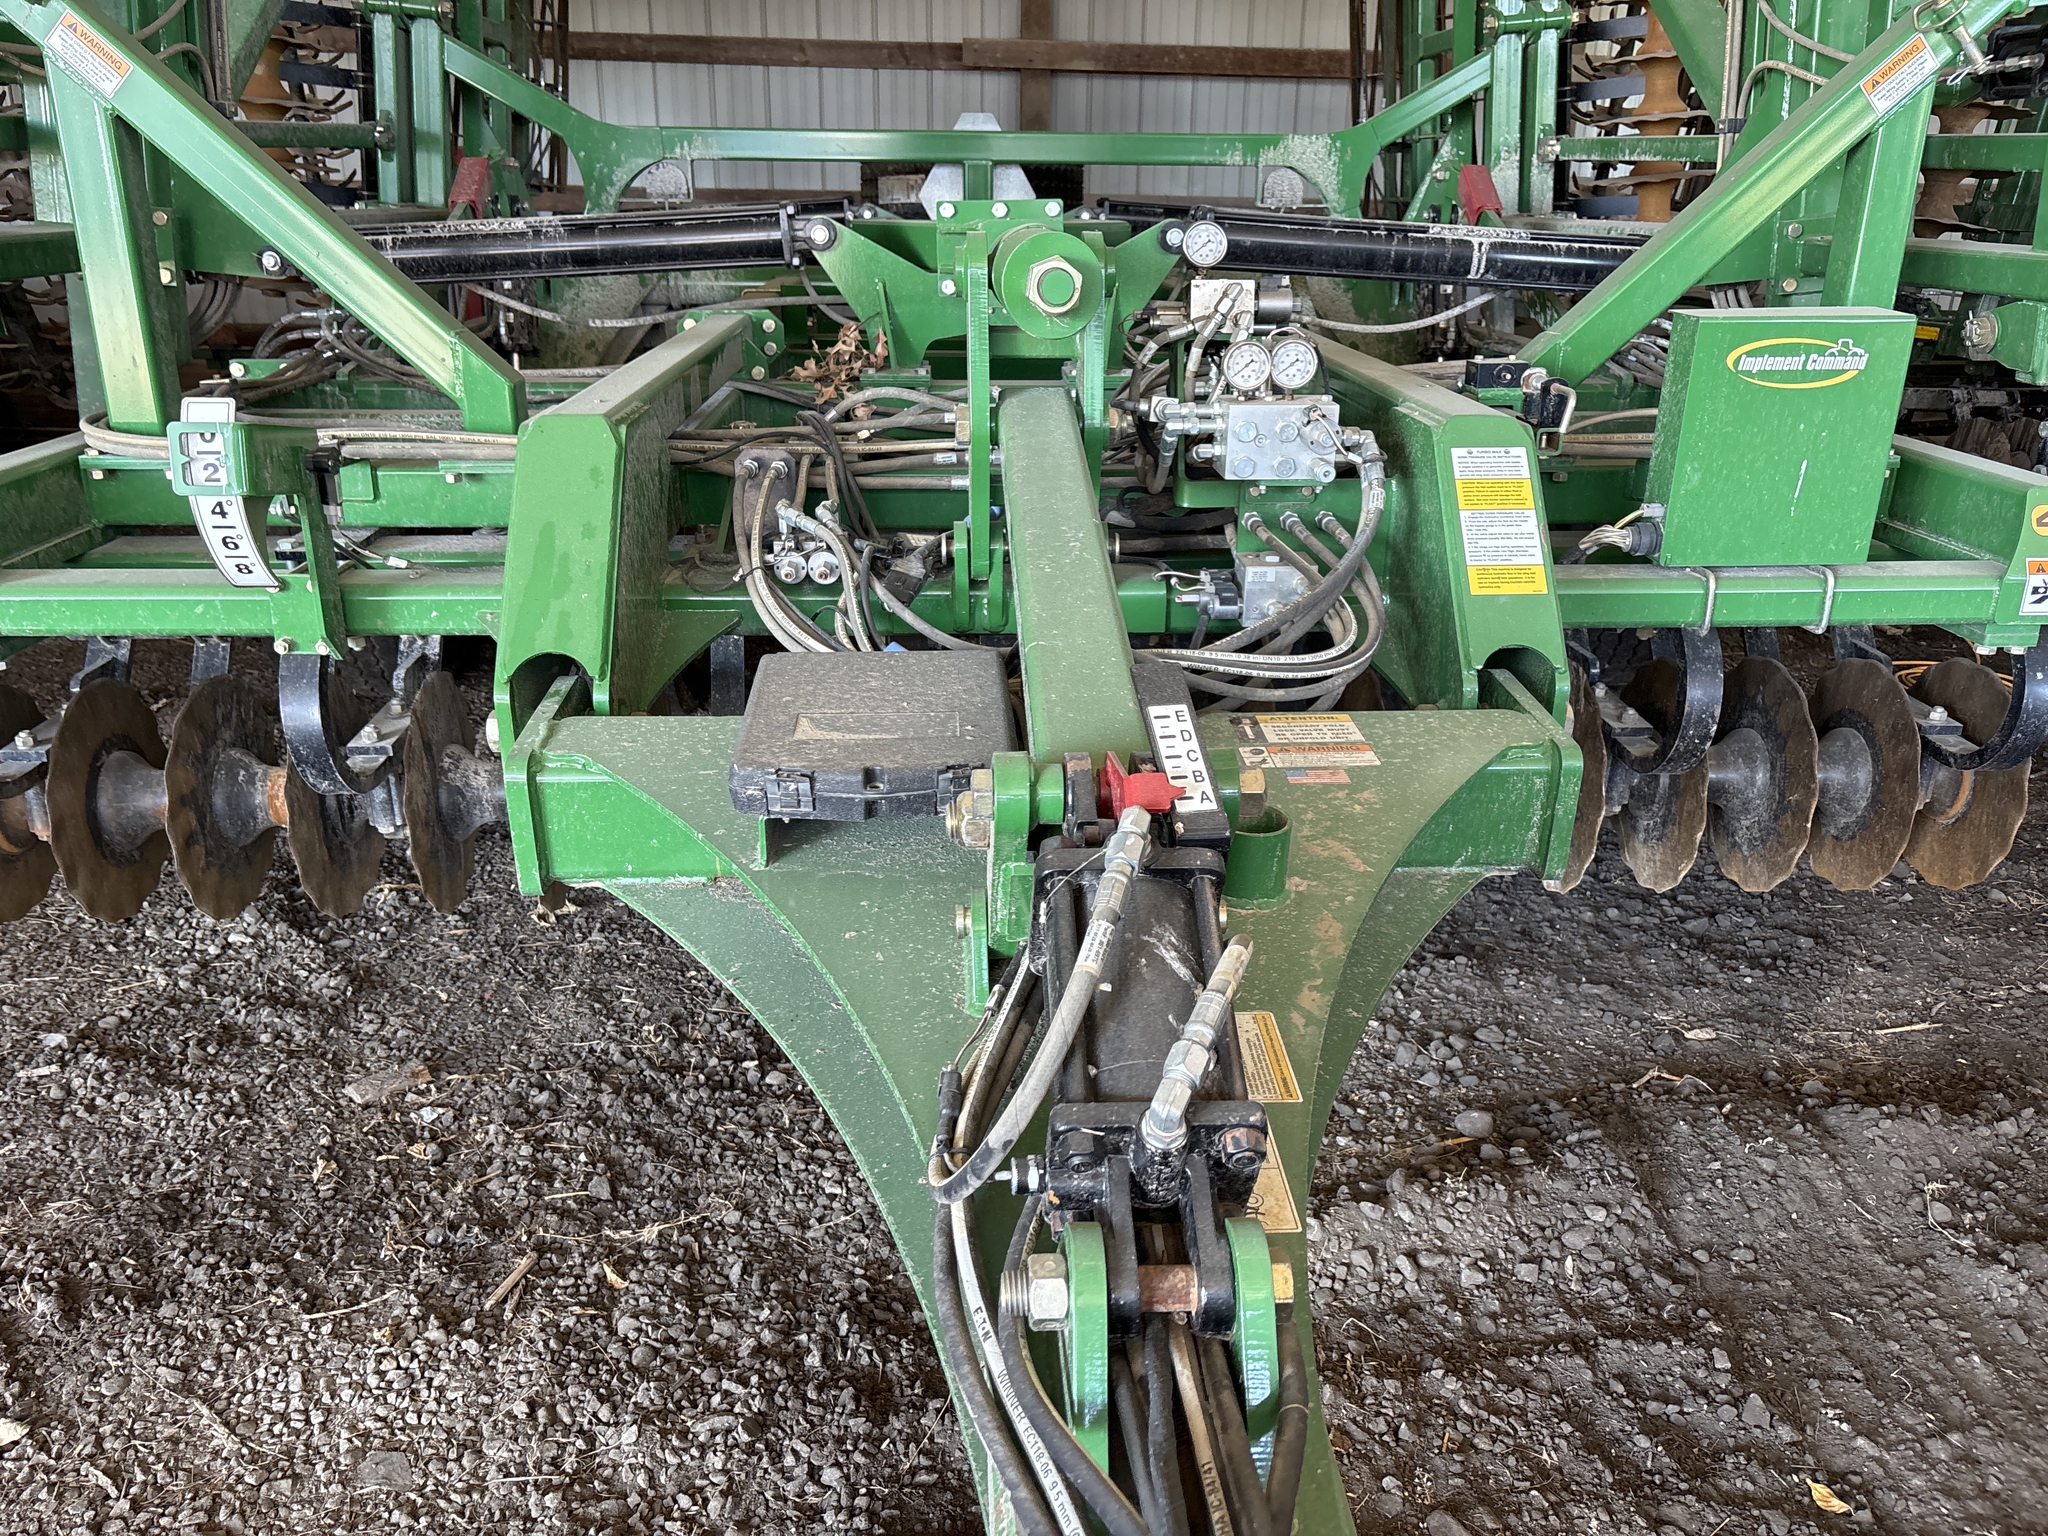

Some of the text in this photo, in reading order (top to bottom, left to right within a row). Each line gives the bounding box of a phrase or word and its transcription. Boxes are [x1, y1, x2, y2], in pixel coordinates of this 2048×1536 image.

[80, 29, 123, 70] WARNING
[1879, 44, 1919, 79] WARNING
[1738, 354, 1869, 373] Implement Command
[1187, 663, 1219, 671] WINNER
[1175, 710, 1187, 722] E
[1180, 730, 1192, 742] D
[1187, 750, 1199, 762] C
[1192, 770, 1205, 783] B
[1201, 791, 1213, 803] A
[997, 1369, 1027, 1426] WINNER
[1023, 1425, 1053, 1480] EC118-06
[1057, 1501, 1073, 1528] mm
